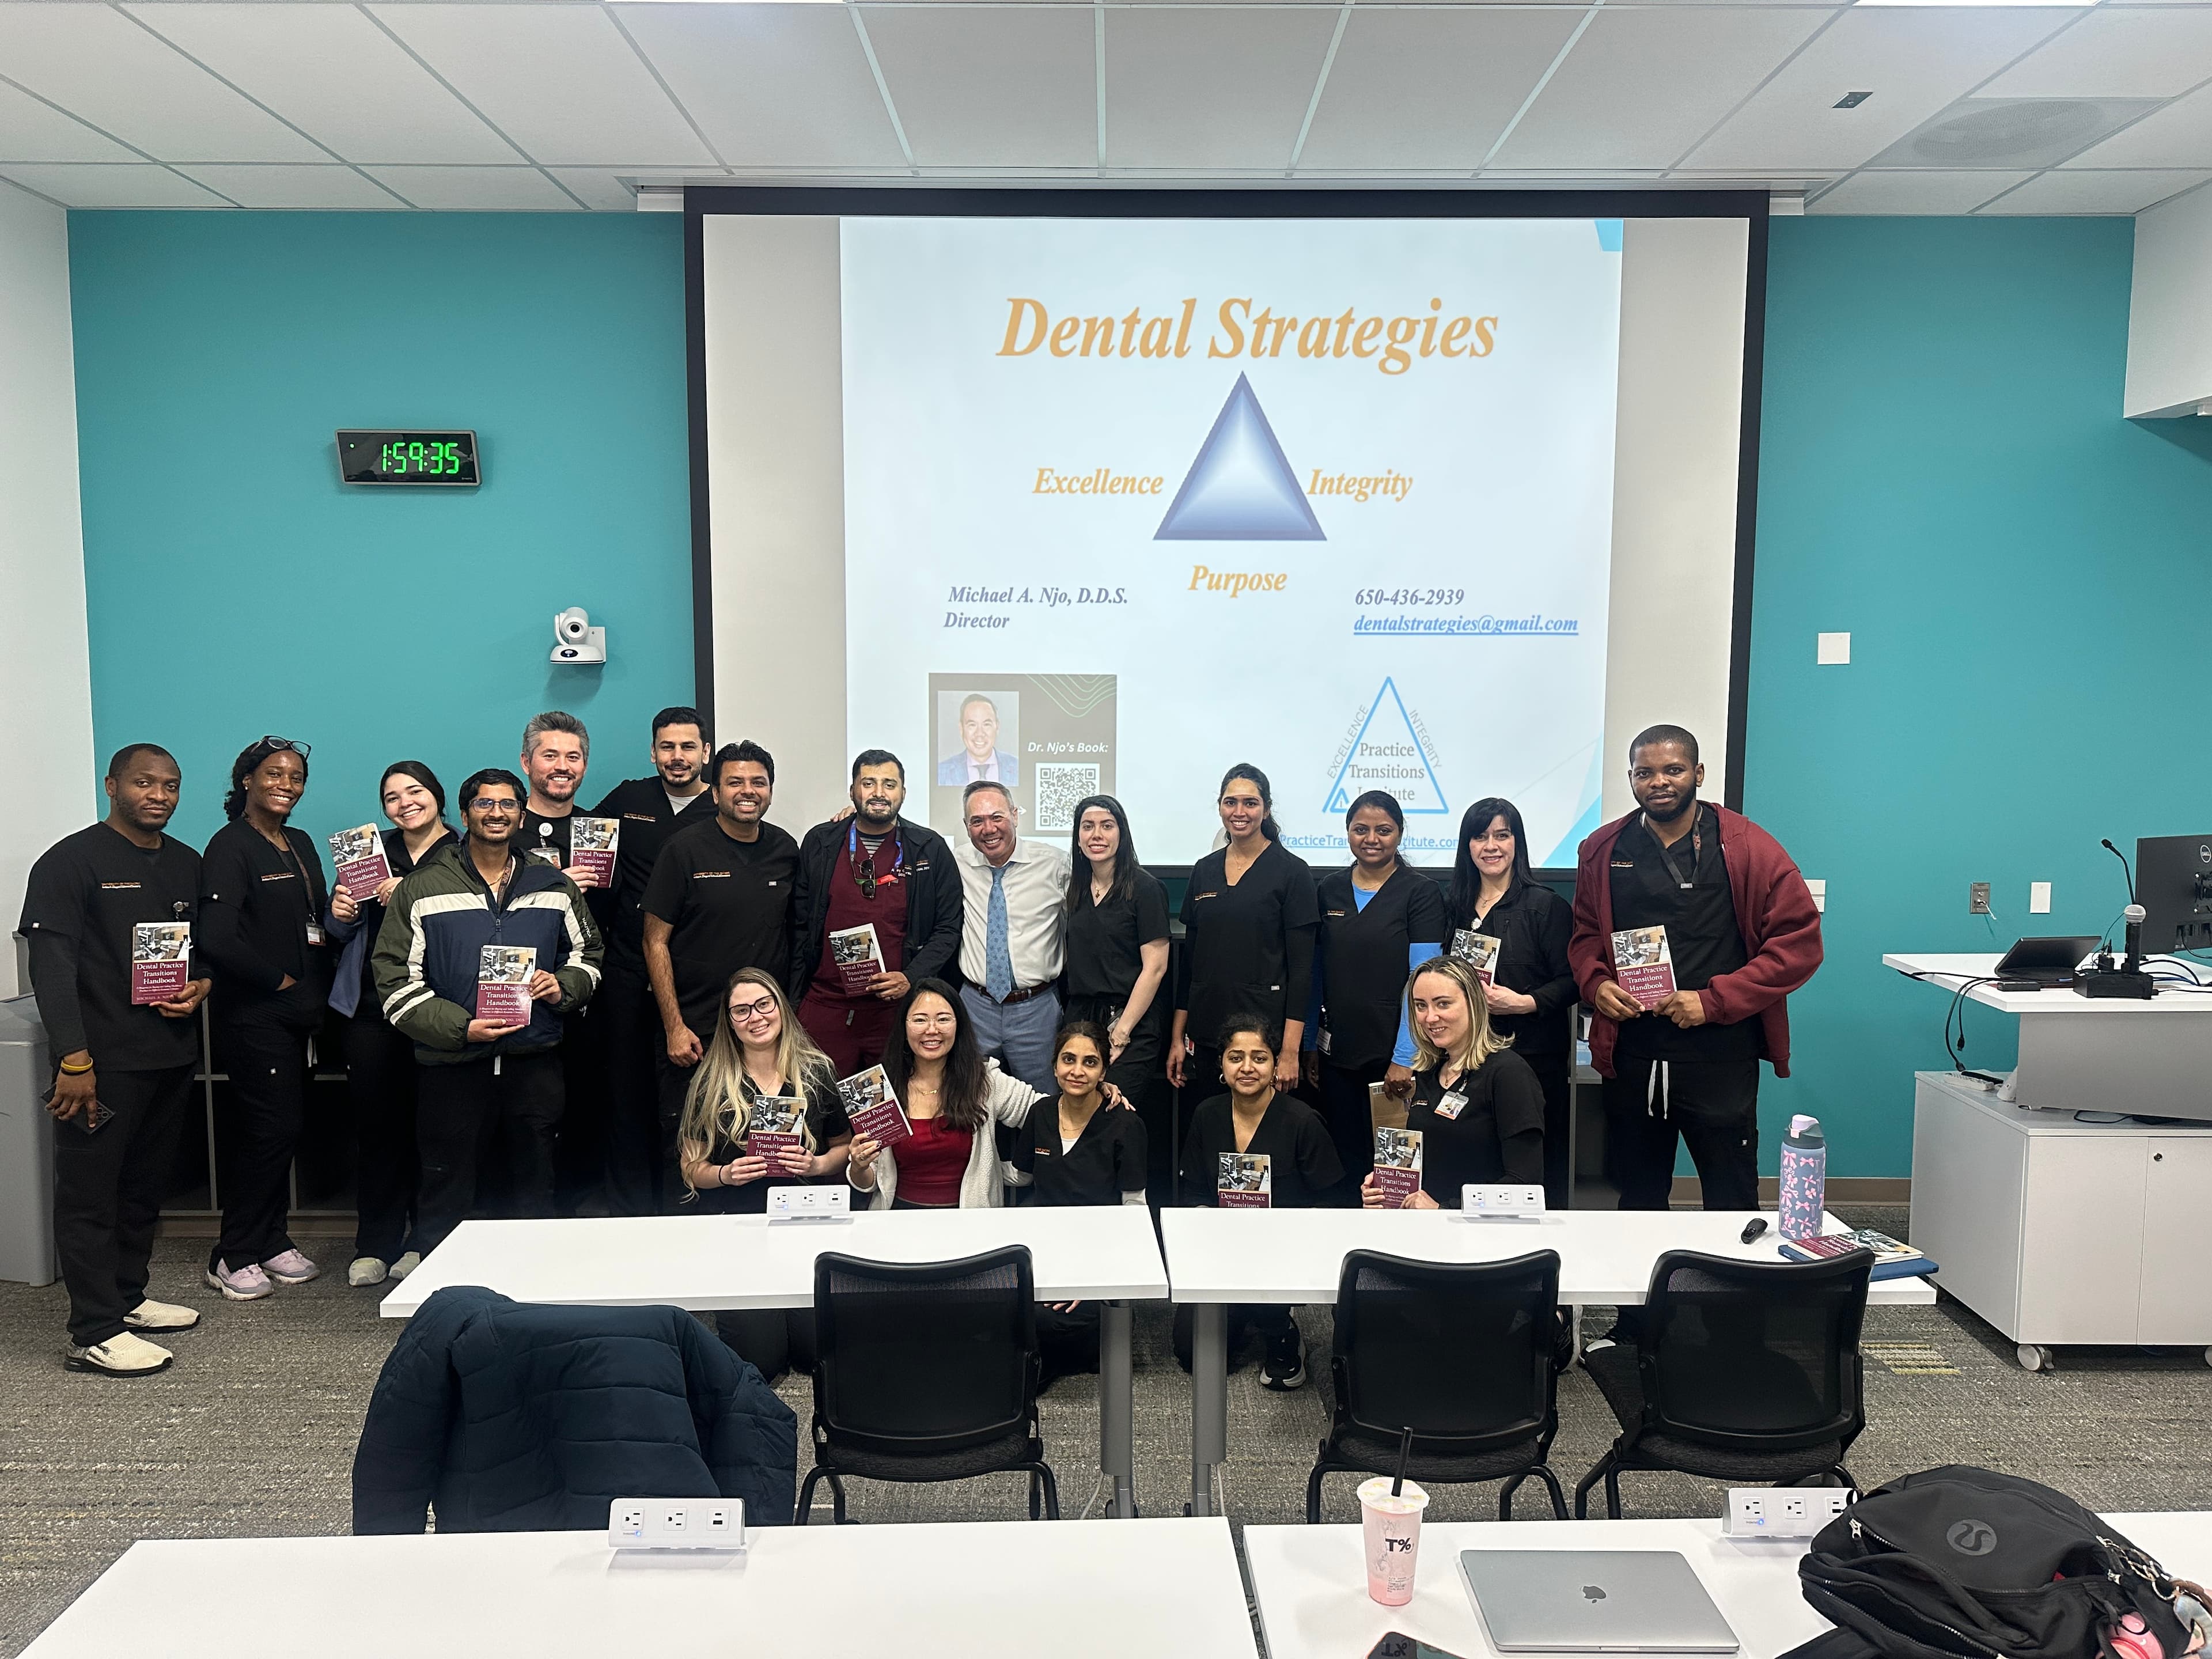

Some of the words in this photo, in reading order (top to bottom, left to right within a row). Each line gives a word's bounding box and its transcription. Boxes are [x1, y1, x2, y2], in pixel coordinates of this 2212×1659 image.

[995, 297, 1197, 358] Dental
[1208, 297, 1498, 374] Strategies
[382, 442, 460, 474] 1:59:35
[1032, 468, 1164, 495] Excellence
[1306, 468, 1413, 502] Integrity
[1188, 565, 1287, 599] Purpose
[948, 586, 1013, 603] Michael
[1016, 587, 1034, 604] A.
[1039, 588, 1071, 608] Njo,
[1076, 588, 1127, 604] D.D.S.
[1355, 588, 1465, 605] 650-436-2939
[943, 612, 1010, 628] Director
[1354, 614, 1579, 635] dentalstrategies@gmail.com
[1327, 704, 1369, 779] EXCELLENCE
[1409, 709, 1443, 769] INTEGRITY
[1028, 742, 1044, 753] Dr.
[1047, 742, 1075, 756] Njo's
[1077, 742, 1109, 753] Book:
[1360, 743, 1415, 757] Practice
[1349, 764, 1425, 779] Transitions
[338, 862, 358, 873] Dental
[358, 857, 381, 866] Practice
[346, 865, 378, 877] Transitions
[348, 871, 379, 884] Handbook
[846, 968, 874, 976] Transitions
[1620, 968, 1642, 977] Dental
[1643, 965, 1668, 974] Practice
[1627, 975, 1663, 984] Transitions
[1630, 982, 1664, 992] Handbook
[852, 1112, 872, 1124] Dental
[871, 1103, 895, 1116] Practice
[860, 1112, 892, 1129] Transitions
[1376, 1168, 1394, 1176] Dental
[1396, 1171, 1416, 1179] Practice
[1380, 1177, 1411, 1187] Transitions
[1381, 1185, 1410, 1195] Handbook
[1385, 1537, 1411, 1552] T%
